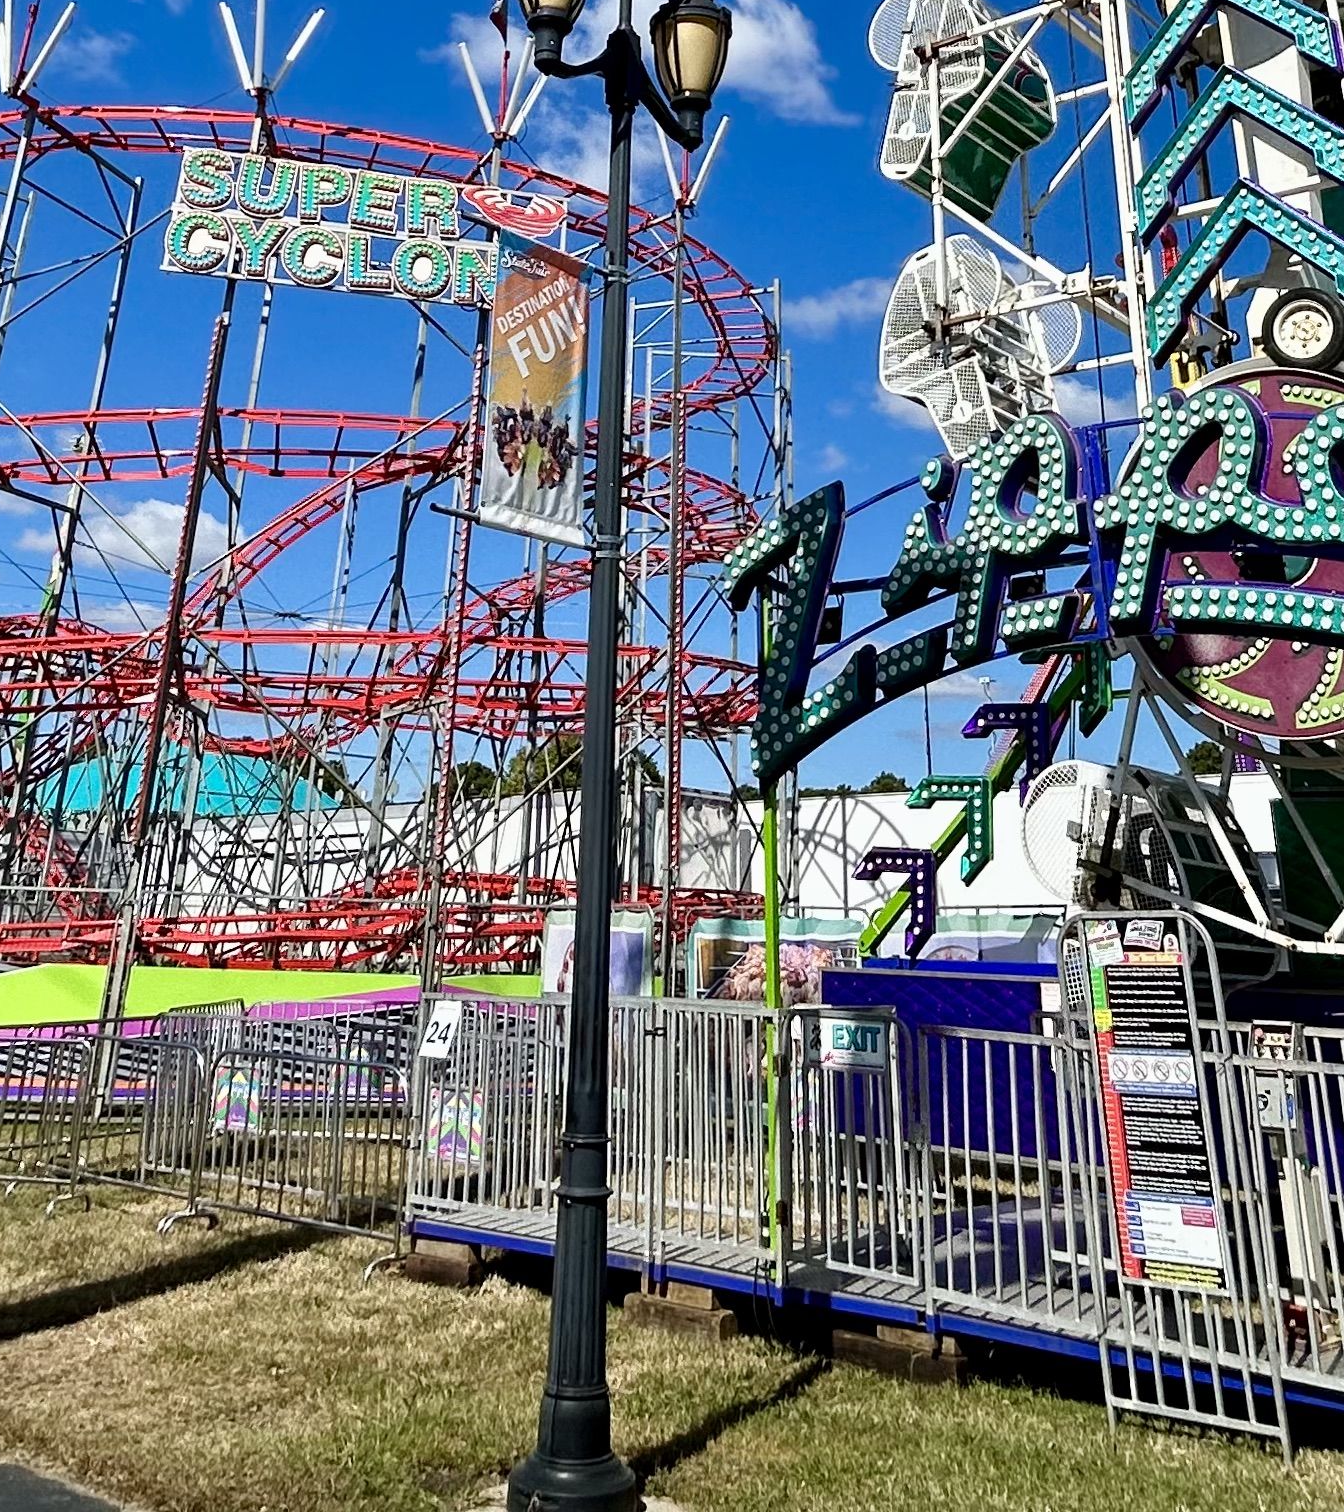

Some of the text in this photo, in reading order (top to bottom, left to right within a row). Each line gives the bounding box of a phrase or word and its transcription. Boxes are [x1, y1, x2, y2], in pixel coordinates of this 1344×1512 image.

[180, 148, 460, 238] SUPER
[165, 210, 501, 306] CYCLON
[500, 248, 532, 274] State
[495, 273, 570, 335] DESTINATION
[506, 294, 587, 379] FUN!
[426, 1020, 451, 1044] 24
[832, 1024, 881, 1053] EXIT
